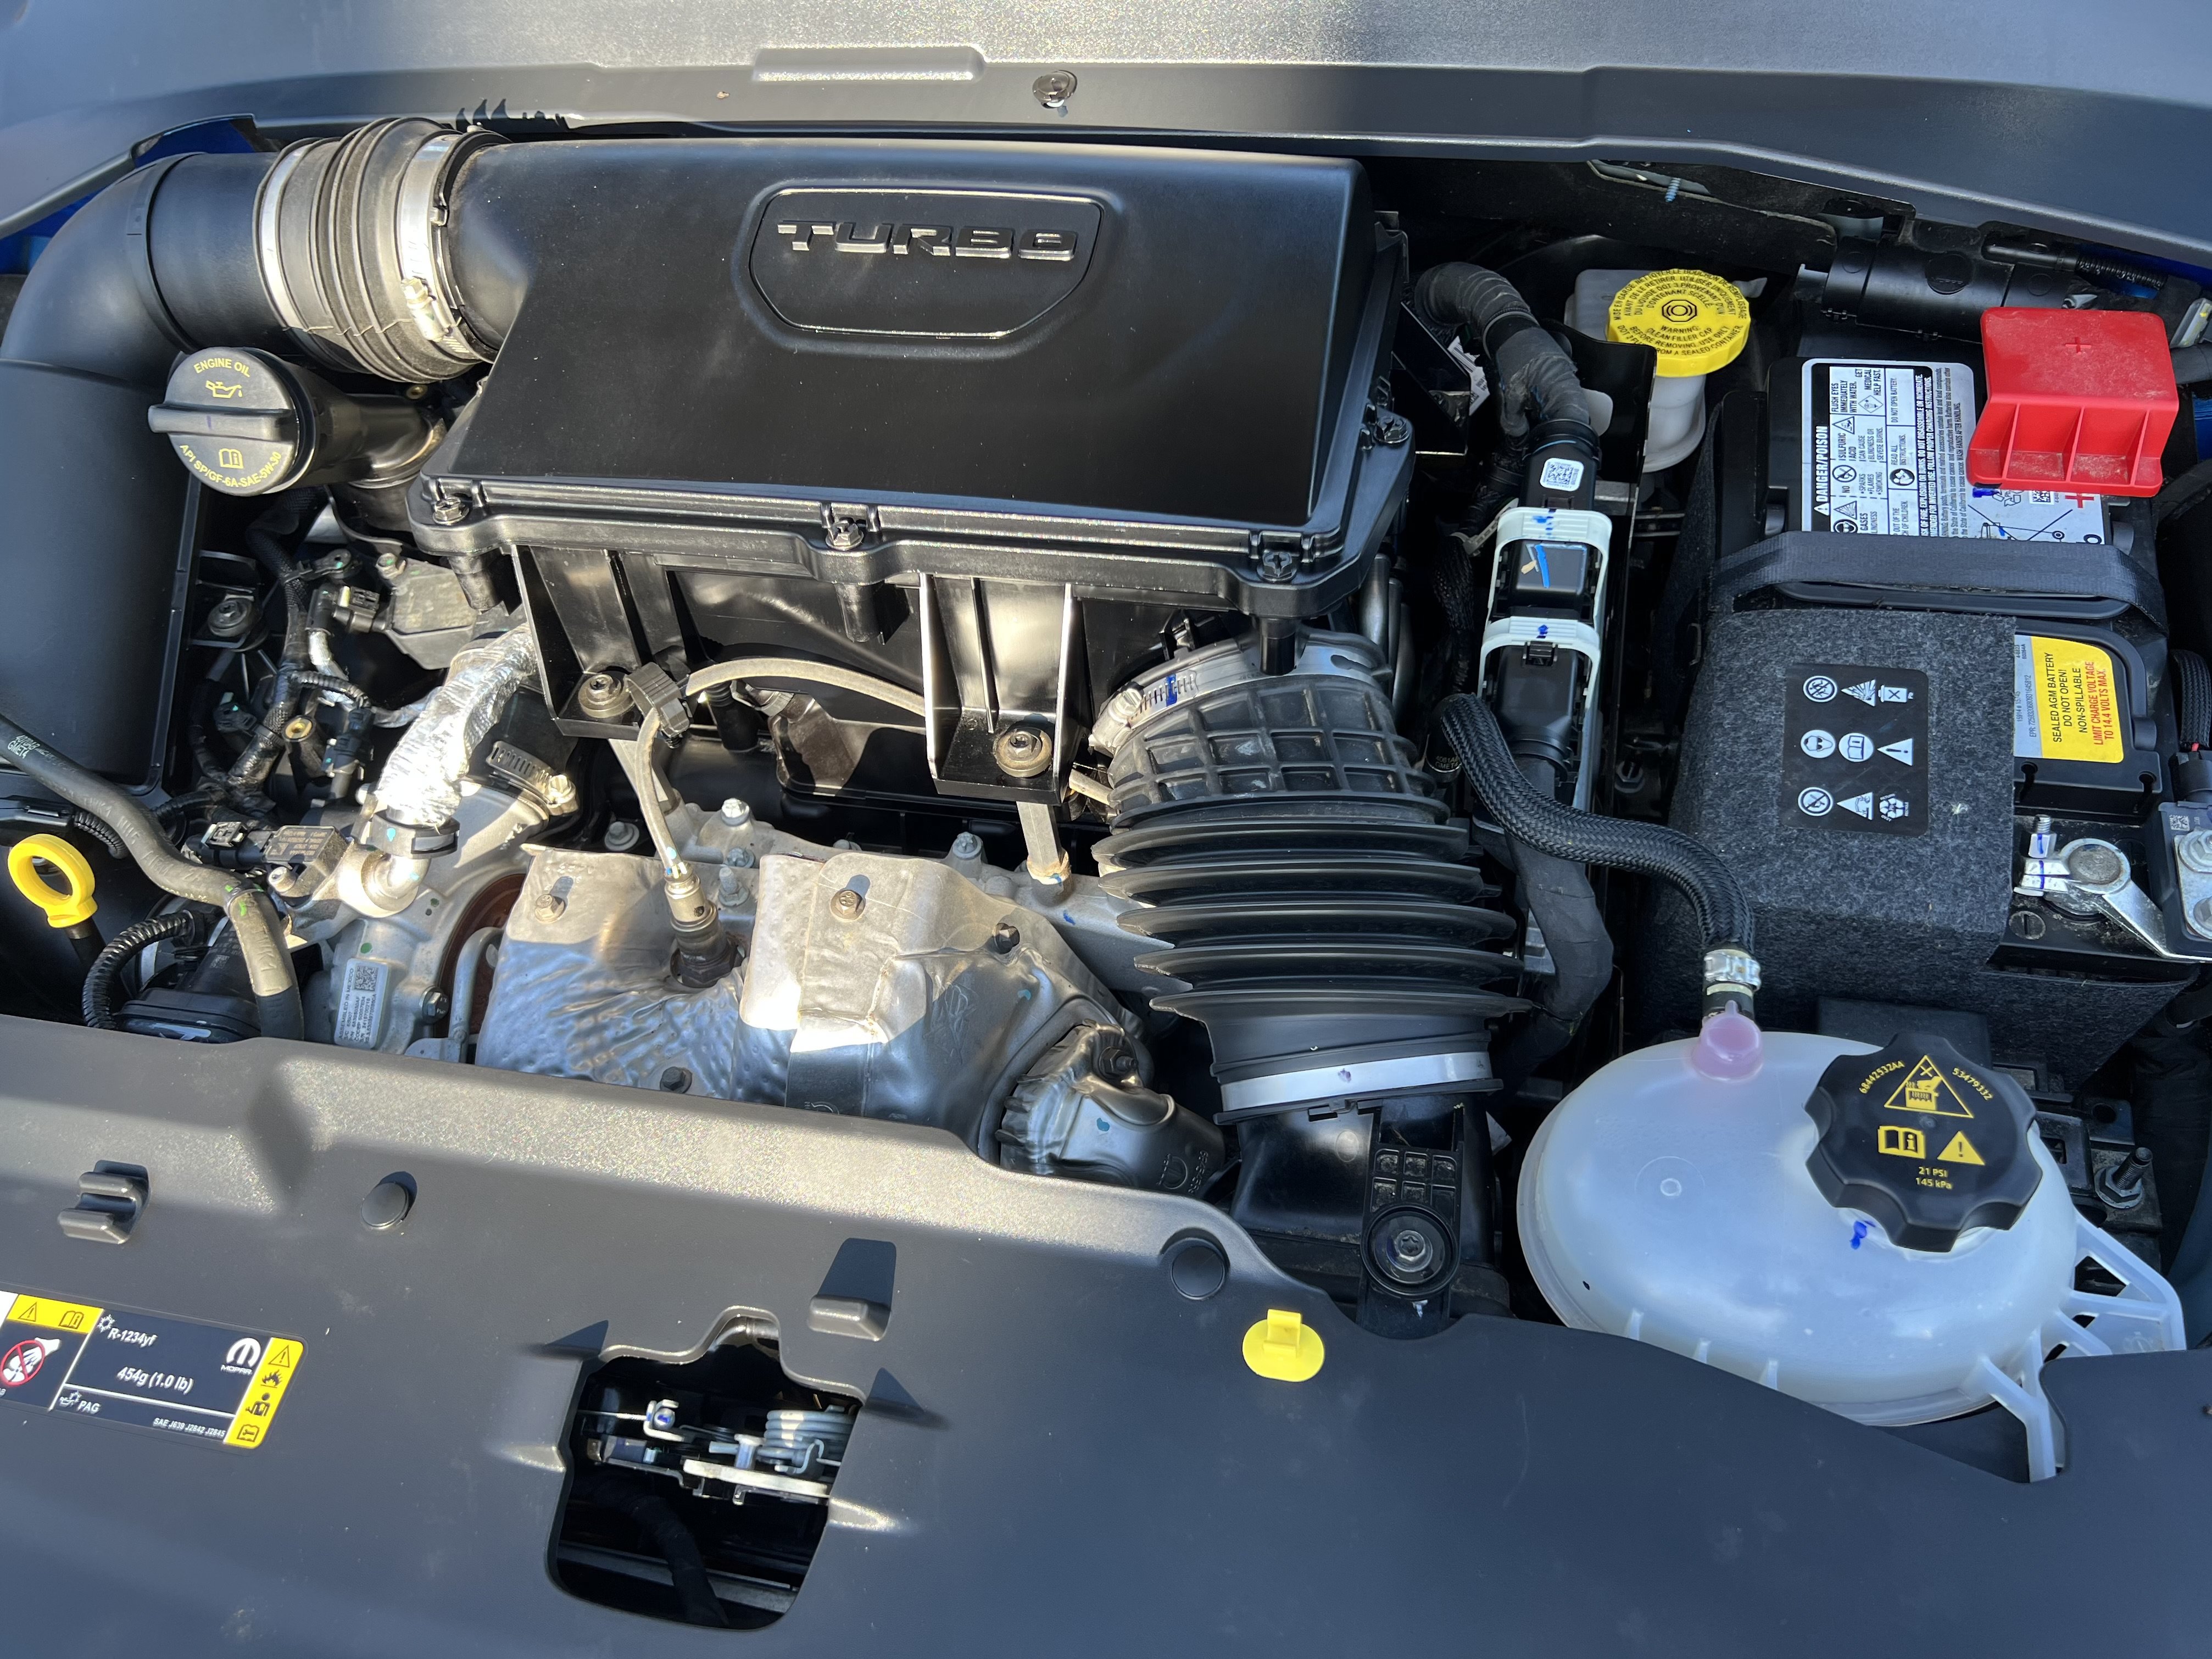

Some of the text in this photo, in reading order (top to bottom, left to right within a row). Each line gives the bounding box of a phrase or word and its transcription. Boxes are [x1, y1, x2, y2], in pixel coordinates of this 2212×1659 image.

[777, 220, 1078, 261] TURBO
[1624, 300, 1634, 316] AVANT
[1636, 287, 1646, 296] LE
[1680, 276, 1712, 286] UTILISER
[1710, 285, 1736, 315] UNIQUEMENT
[1637, 289, 1657, 307] LIQUIDE
[1657, 282, 1670, 291] DOT
[1681, 283, 1721, 302] PROVENANT
[1646, 290, 1686, 308] CONTENANT
[1728, 285, 1747, 319] REMPLISSAGE
[1617, 325, 1626, 336] DOT
[1681, 347, 1710, 355] SEALED
[1630, 326, 1729, 346] BEFORE USE ONLY
[1647, 327, 1670, 340] CLEAN
[1699, 327, 1713, 337] CAP
[193, 358, 250, 378] ENGINE OIL
[1915, 374, 1924, 400] INCINERATE.
[1924, 376, 1932, 409] INSTRUCTIONS.
[1916, 408, 1925, 439] DISASSEMBLE
[1925, 409, 1934, 432] CHARGING
[179, 444, 196, 462] API
[1838, 433, 1846, 458] SULFURIC
[1925, 433, 1934, 450] PROPER
[1816, 426, 1828, 502] DANGER/POISON
[1927, 451, 1935, 470] FOLLOW
[1919, 483, 1927, 508] EXPLOSION
[1860, 513, 1868, 531] GASES
[2044, 652, 2061, 742] SEALED AGM BATTERY
[2058, 669, 2072, 727] DO NOT OPEN!
[2072, 667, 2087, 733] NON-SPILLABLE
[2085, 661, 2103, 745] LIMIT CHARGE VOLTAGE
[2097, 669, 2114, 739] TO 14.4 VOLTS MAX.
[338, 1001, 349, 1038] ASSEMBLED
[1859, 1060, 1905, 1094] 68442532AA
[1952, 1067, 1993, 1101] 53479332
[1915, 1177, 1952, 1189] 145 kPa
[1918, 1166, 1948, 1177] 21 PSI
[107, 1327, 158, 1348] R-1234yf
[115, 1367, 194, 1395] 454g (1.0 lb)
[76, 1400, 102, 1414] PAG
[153, 1417, 226, 1439] SAE J639 J2842 J2845
